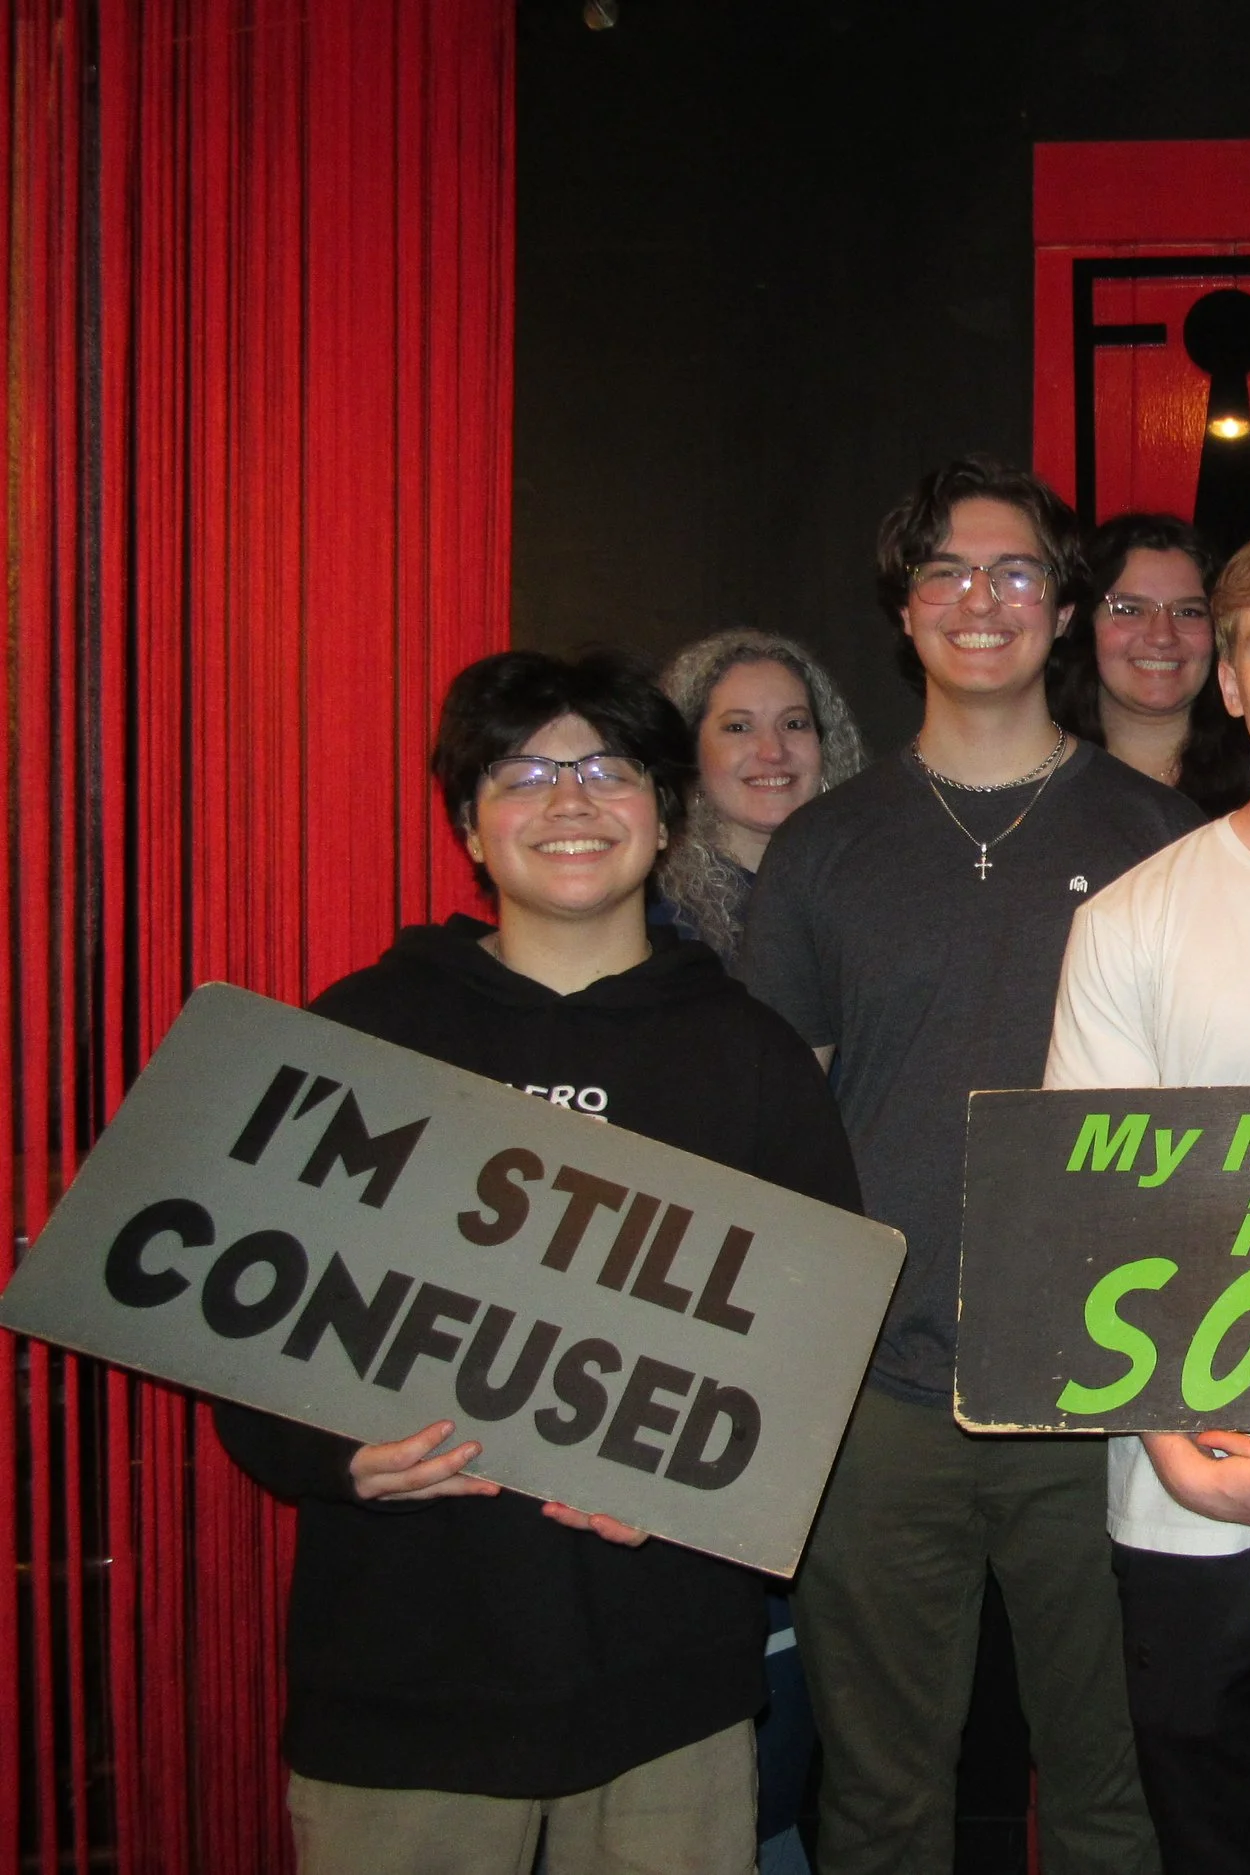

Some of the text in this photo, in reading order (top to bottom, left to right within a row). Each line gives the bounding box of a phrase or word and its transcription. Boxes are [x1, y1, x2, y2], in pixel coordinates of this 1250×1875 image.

[229, 1065, 757, 1335] I'M STILL
[1066, 1113, 1203, 1188] My
[104, 1198, 762, 1492] CONFUSED
